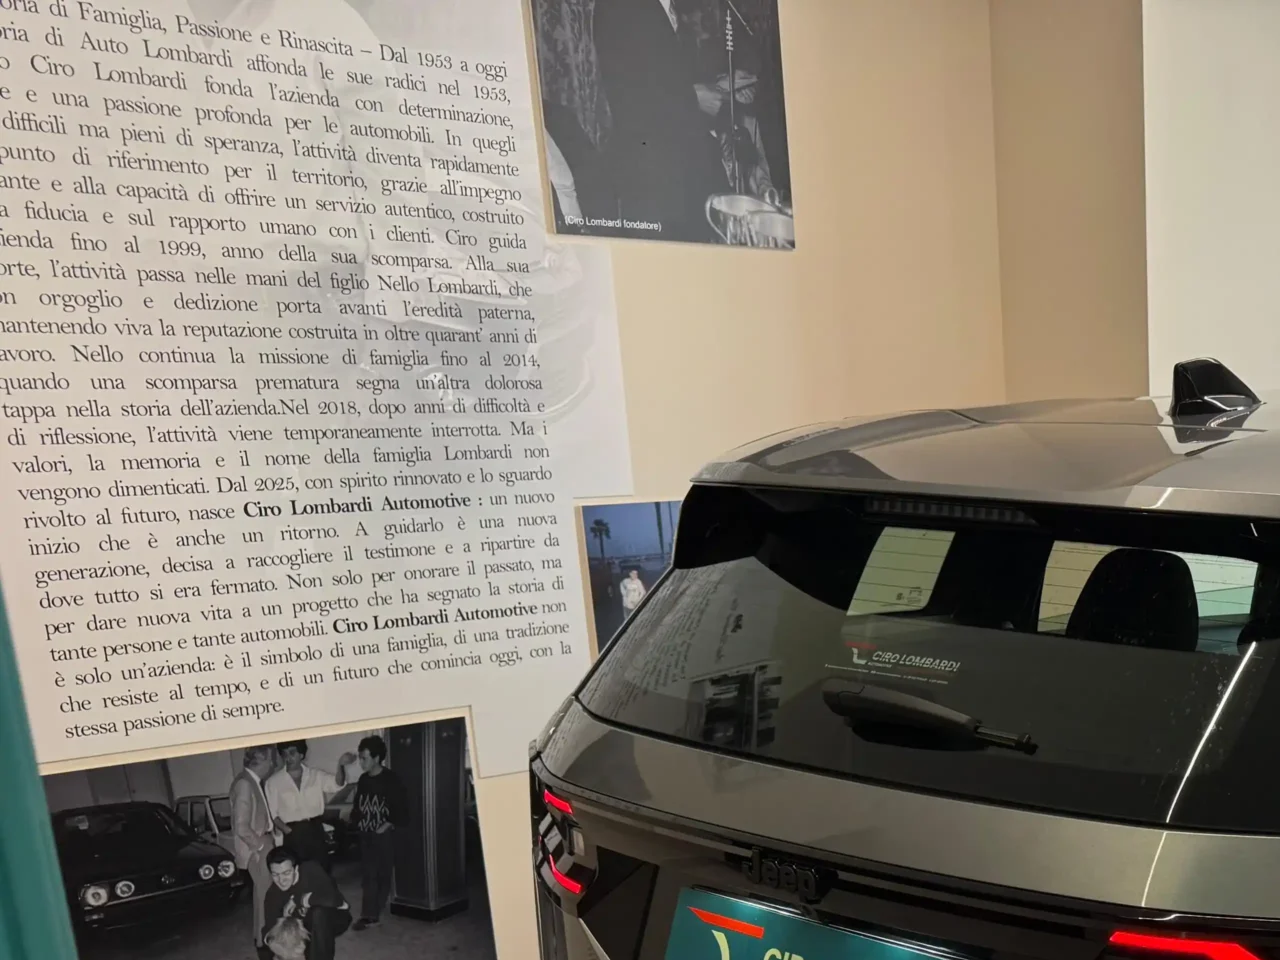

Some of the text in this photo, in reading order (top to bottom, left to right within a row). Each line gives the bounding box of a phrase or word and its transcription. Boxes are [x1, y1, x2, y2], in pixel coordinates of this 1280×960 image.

[49, 0, 69, 18] di
[76, 1, 167, 35] Famiglia,
[175, 15, 252, 43] Passione
[260, 33, 271, 45] e
[278, 29, 354, 57] Rinascita
[379, 44, 408, 64] Dal
[418, 52, 452, 69] 1953
[460, 61, 469, 72] a
[475, 61, 508, 82] oggi
[30, 54, 514, 130] Ciro Lombardi fonda l'azienda con determinazione,
[2, 110, 519, 176] difficili ma pieni di speranza, l'attività diventa rapidamente
[51, 180, 62, 192] e
[73, 175, 107, 195] alla
[116, 182, 189, 204] capacità
[198, 184, 215, 203] di
[224, 187, 276, 207] offrire
[285, 197, 307, 209] un
[316, 196, 376, 214] servizio
[385, 202, 455, 223] autentico,
[462, 208, 524, 225] costruito
[586, 217, 621, 228] Lombardi
[70, 232, 107, 251] fino
[124, 235, 140, 253] al
[159, 240, 206, 260] 1999,
[221, 246, 264, 259] anno
[278, 243, 317, 262] della
[331, 252, 358, 264] sua
[371, 254, 452, 273] scomparsa.
[466, 255, 495, 272] Alla
[506, 262, 530, 273] sua
[0, 344, 540, 371] avoro. Nello continua la missione di famiglia fino al 2014,
[1, 403, 56, 424] tappa
[65, 399, 111, 417] nella
[121, 399, 172, 417] storia
[318, 401, 361, 417] 2018,
[368, 398, 406, 419] dopo
[414, 398, 446, 414] anni
[453, 398, 466, 413] di
[473, 397, 531, 413] difficoltà
[537, 403, 545, 412] e
[12, 444, 550, 475] valori, la memoria e il nome della famiglia Lombardi non
[23, 509, 86, 529] rivolto
[96, 507, 112, 525] al
[121, 506, 180, 525] futuro,
[188, 508, 235, 521] nasce
[243, 501, 282, 518] Ciro
[289, 496, 373, 516] Lombardi
[381, 492, 471, 511] Automotive
[489, 495, 507, 506] un
[514, 493, 555, 504] nuovo
[35, 532, 560, 589] generazione, decisa a raccogliere il testimone e a ripartire da
[44, 576, 564, 641] per dare nuova vita a un progetto che ha segnato la storia di
[54, 621, 569, 688] è solo un'azienda: è il simbolo di una famiglia, di una tradizione
[872, 650, 961, 672] CIRO LOMBARDI
[65, 702, 284, 738] stessa passione di sempre.
[741, 846, 817, 903] Jeep
